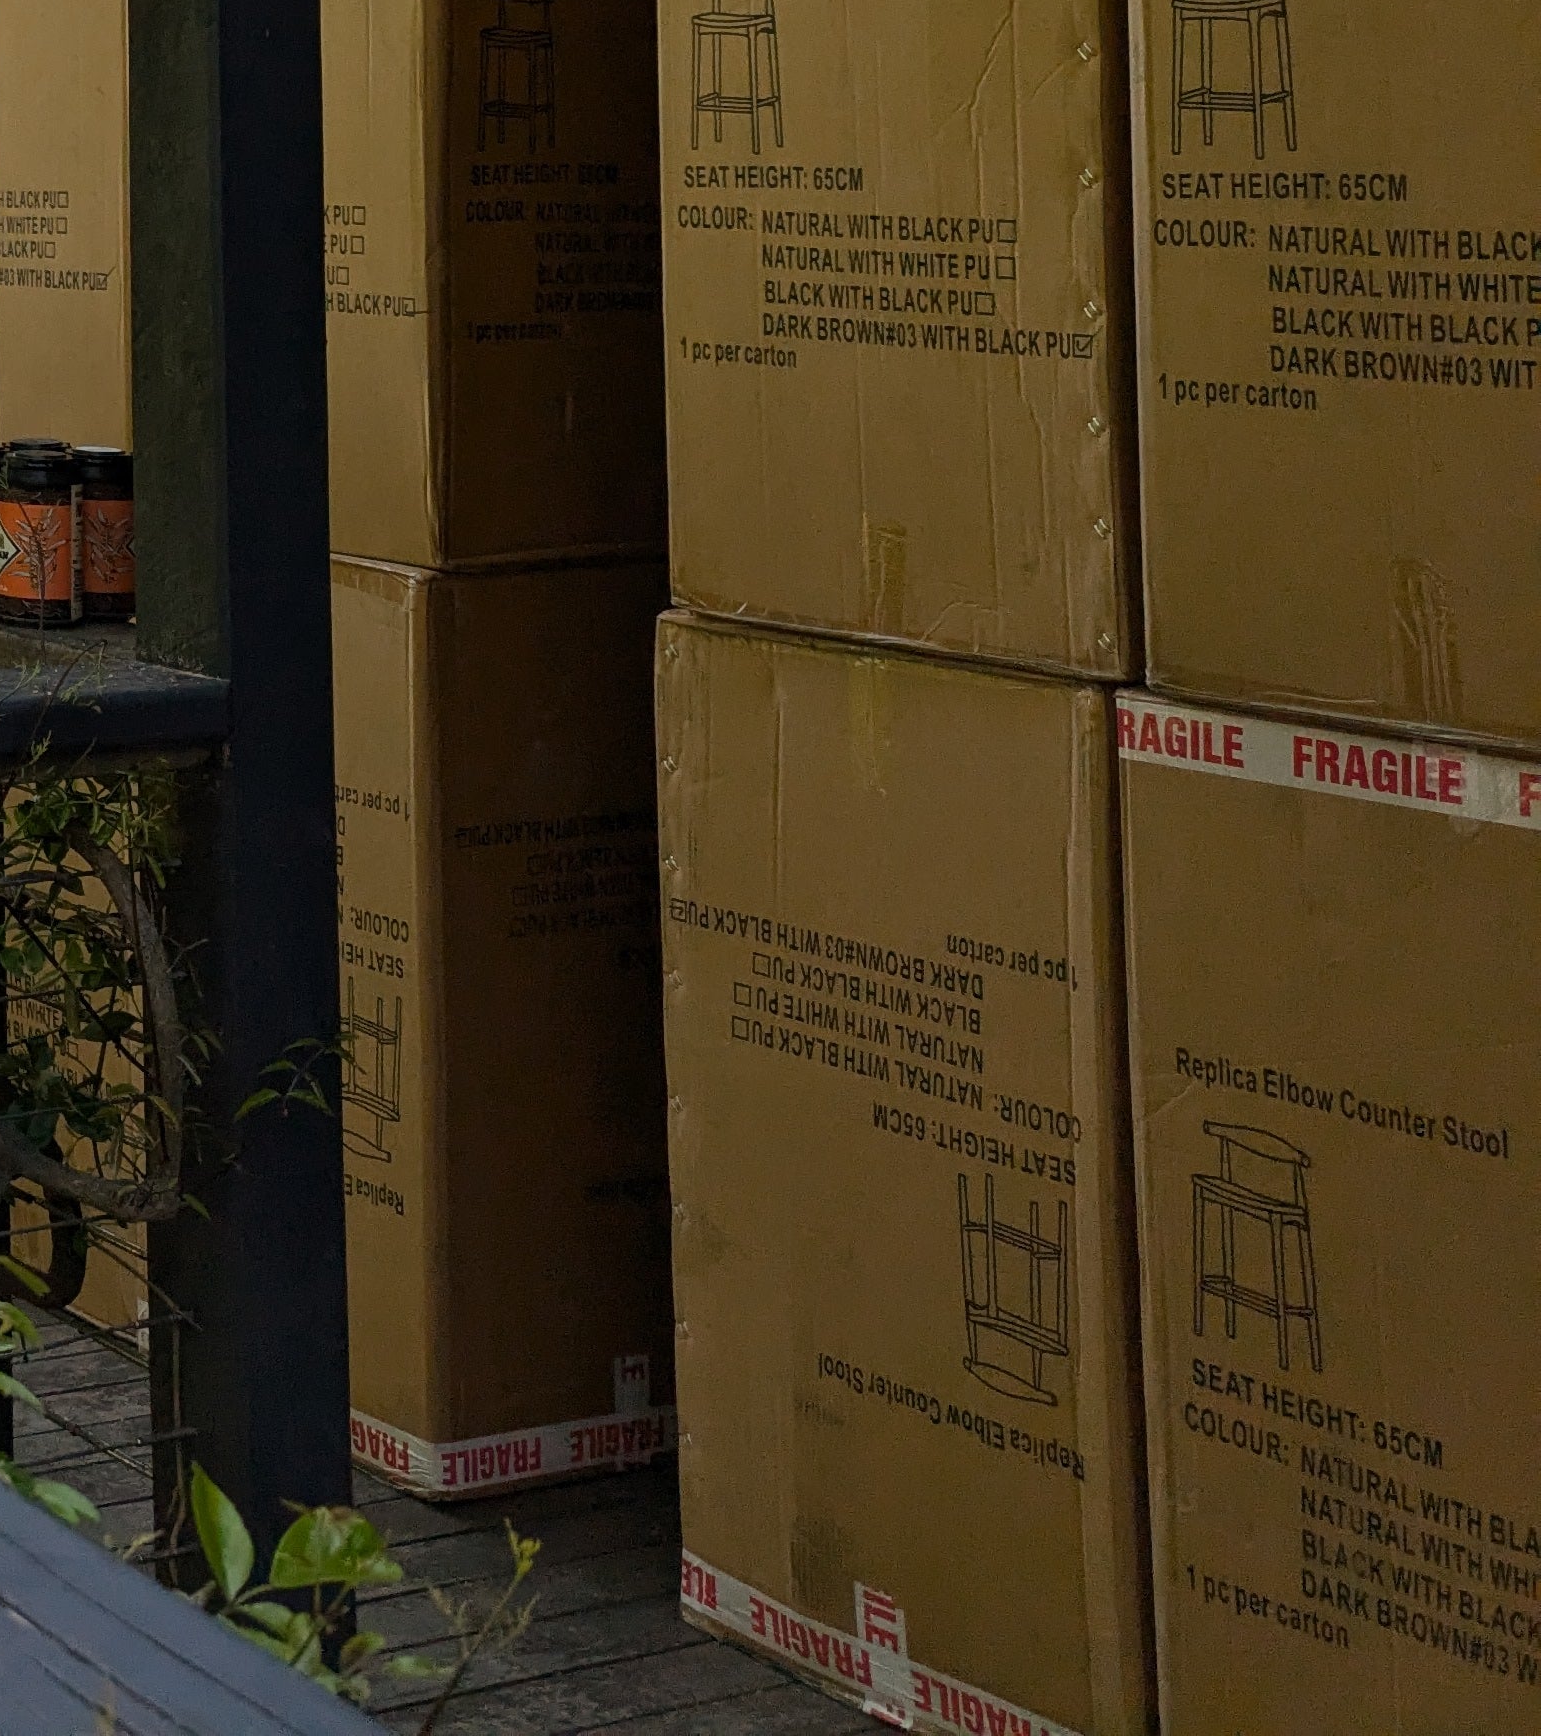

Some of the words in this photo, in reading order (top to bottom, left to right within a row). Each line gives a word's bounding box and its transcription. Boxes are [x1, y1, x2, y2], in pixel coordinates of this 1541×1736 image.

[684, 165, 729, 190] SEAT
[735, 166, 808, 191] HEIGHT:
[813, 167, 864, 192] 65CM
[1163, 173, 1224, 199] SEAT
[1231, 172, 1330, 201] HEIGHT:
[1339, 174, 1408, 202] 65CM
[7, 190, 41, 208] BLACK
[333, 205, 350, 226] PU
[7, 216, 38, 234] WHITE
[678, 205, 754, 231] COLOUR:
[762, 209, 844, 239] NATURAL
[848, 214, 893, 240] WITH
[898, 217, 964, 243] BLACK
[969, 219, 994, 244] PU
[1153, 219, 1256, 248] COLOUR:
[1269, 224, 1381, 257] NATURAL
[1386, 228, 1450, 259] WITH
[330, 234, 348, 254] PU
[762, 245, 845, 274] NATURAL
[849, 249, 894, 276] WITH
[899, 252, 959, 279] WHITE
[964, 255, 990, 280] PU
[45, 269, 80, 290] BLACK
[764, 280, 824, 309] BLACK
[828, 284, 874, 311] WITH
[879, 287, 943, 314] BLACK
[947, 291, 972, 316] PU
[1269, 265, 1382, 298] NATURAL
[1388, 269, 1451, 301] WITH
[1458, 271, 1541, 304] WHITE
[337, 293, 381, 315] BLACK
[384, 295, 401, 317] PU
[763, 312, 812, 339] DARK
[817, 318, 917, 348] BROWN#03
[922, 323, 970, 353] WITH
[975, 327, 1040, 358] BLACK
[1046, 332, 1071, 359] PU
[1273, 306, 1354, 338] BLACK
[1359, 311, 1422, 341] WITH
[1430, 314, 1517, 346] BLACK
[680, 336, 688, 360] 1
[692, 340, 711, 364] pc
[716, 343, 741, 367] per
[744, 340, 797, 368] carton
[1270, 345, 1337, 377] DARK
[1344, 349, 1482, 386] BROWN#03
[1489, 359, 1537, 390] WIT
[1159, 373, 1167, 399] 1
[1175, 378, 1199, 406] pc
[1206, 381, 1240, 408] per
[1246, 383, 1317, 411] carton
[1292, 735, 1463, 806] FRAGILE
[363, 791, 381, 810] per
[716, 907, 772, 944] BLACK
[777, 922, 820, 954] WITH
[369, 948, 403, 978] SEAT
[825, 934, 924, 981] BROWN#03
[947, 933, 1004, 961] carton
[1011, 949, 1041, 972] per
[772, 956, 795, 983] PU
[799, 964, 860, 1001] BLACK
[930, 962, 984, 1000] DARK
[1044, 957, 1068, 982] pc
[756, 986, 780, 1013] PU
[783, 994, 839, 1032] WHITE
[866, 980, 912, 1010] WITH
[751, 1021, 774, 1048] PU
[844, 1008, 890, 1046] WITH
[917, 997, 982, 1035] BLACK
[779, 1026, 839, 1067] BLACK
[844, 1045, 890, 1082] WITH
[895, 1024, 983, 1074] NATURAL
[895, 1060, 983, 1111] NATURAL
[1176, 1047, 1257, 1093] Replica
[1263, 1068, 1334, 1114] Elbow
[1340, 1089, 1436, 1140] Counter
[1443, 1115, 1509, 1159] Stool
[872, 1103, 926, 1141] 65CM
[993, 1093, 1082, 1142] COLOUR:
[931, 1118, 1015, 1166] HEIGHT:
[1020, 1148, 1077, 1185] SEAT
[357, 1176, 404, 1216] Replica
[818, 1352, 864, 1395] Stool
[868, 1371, 941, 1425] Counter
[1192, 1358, 1255, 1405] SEAT
[1262, 1382, 1366, 1443] HEIGHT:
[1373, 1421, 1443, 1469] 65CM
[947, 1404, 1005, 1449] Elbow
[442, 1437, 542, 1486] FRAGILE
[1010, 1426, 1085, 1480] Replica
[1183, 1402, 1289, 1464] COLOUR:
[1301, 1446, 1415, 1515] NATURAL
[1420, 1489, 1482, 1539] WITH
[1301, 1486, 1416, 1556] NATURAL
[1421, 1531, 1482, 1582] WITH
[1302, 1530, 1384, 1586] BLACK
[1392, 1564, 1452, 1613] WITH
[1186, 1564, 1195, 1591] 1
[1203, 1575, 1230, 1603] pc
[1235, 1585, 1270, 1618] per
[1276, 1602, 1350, 1648] carton
[1301, 1568, 1370, 1622] DARK
[1376, 1599, 1508, 1674] BROWN#03
[749, 1594, 872, 1688] FRAGILE
